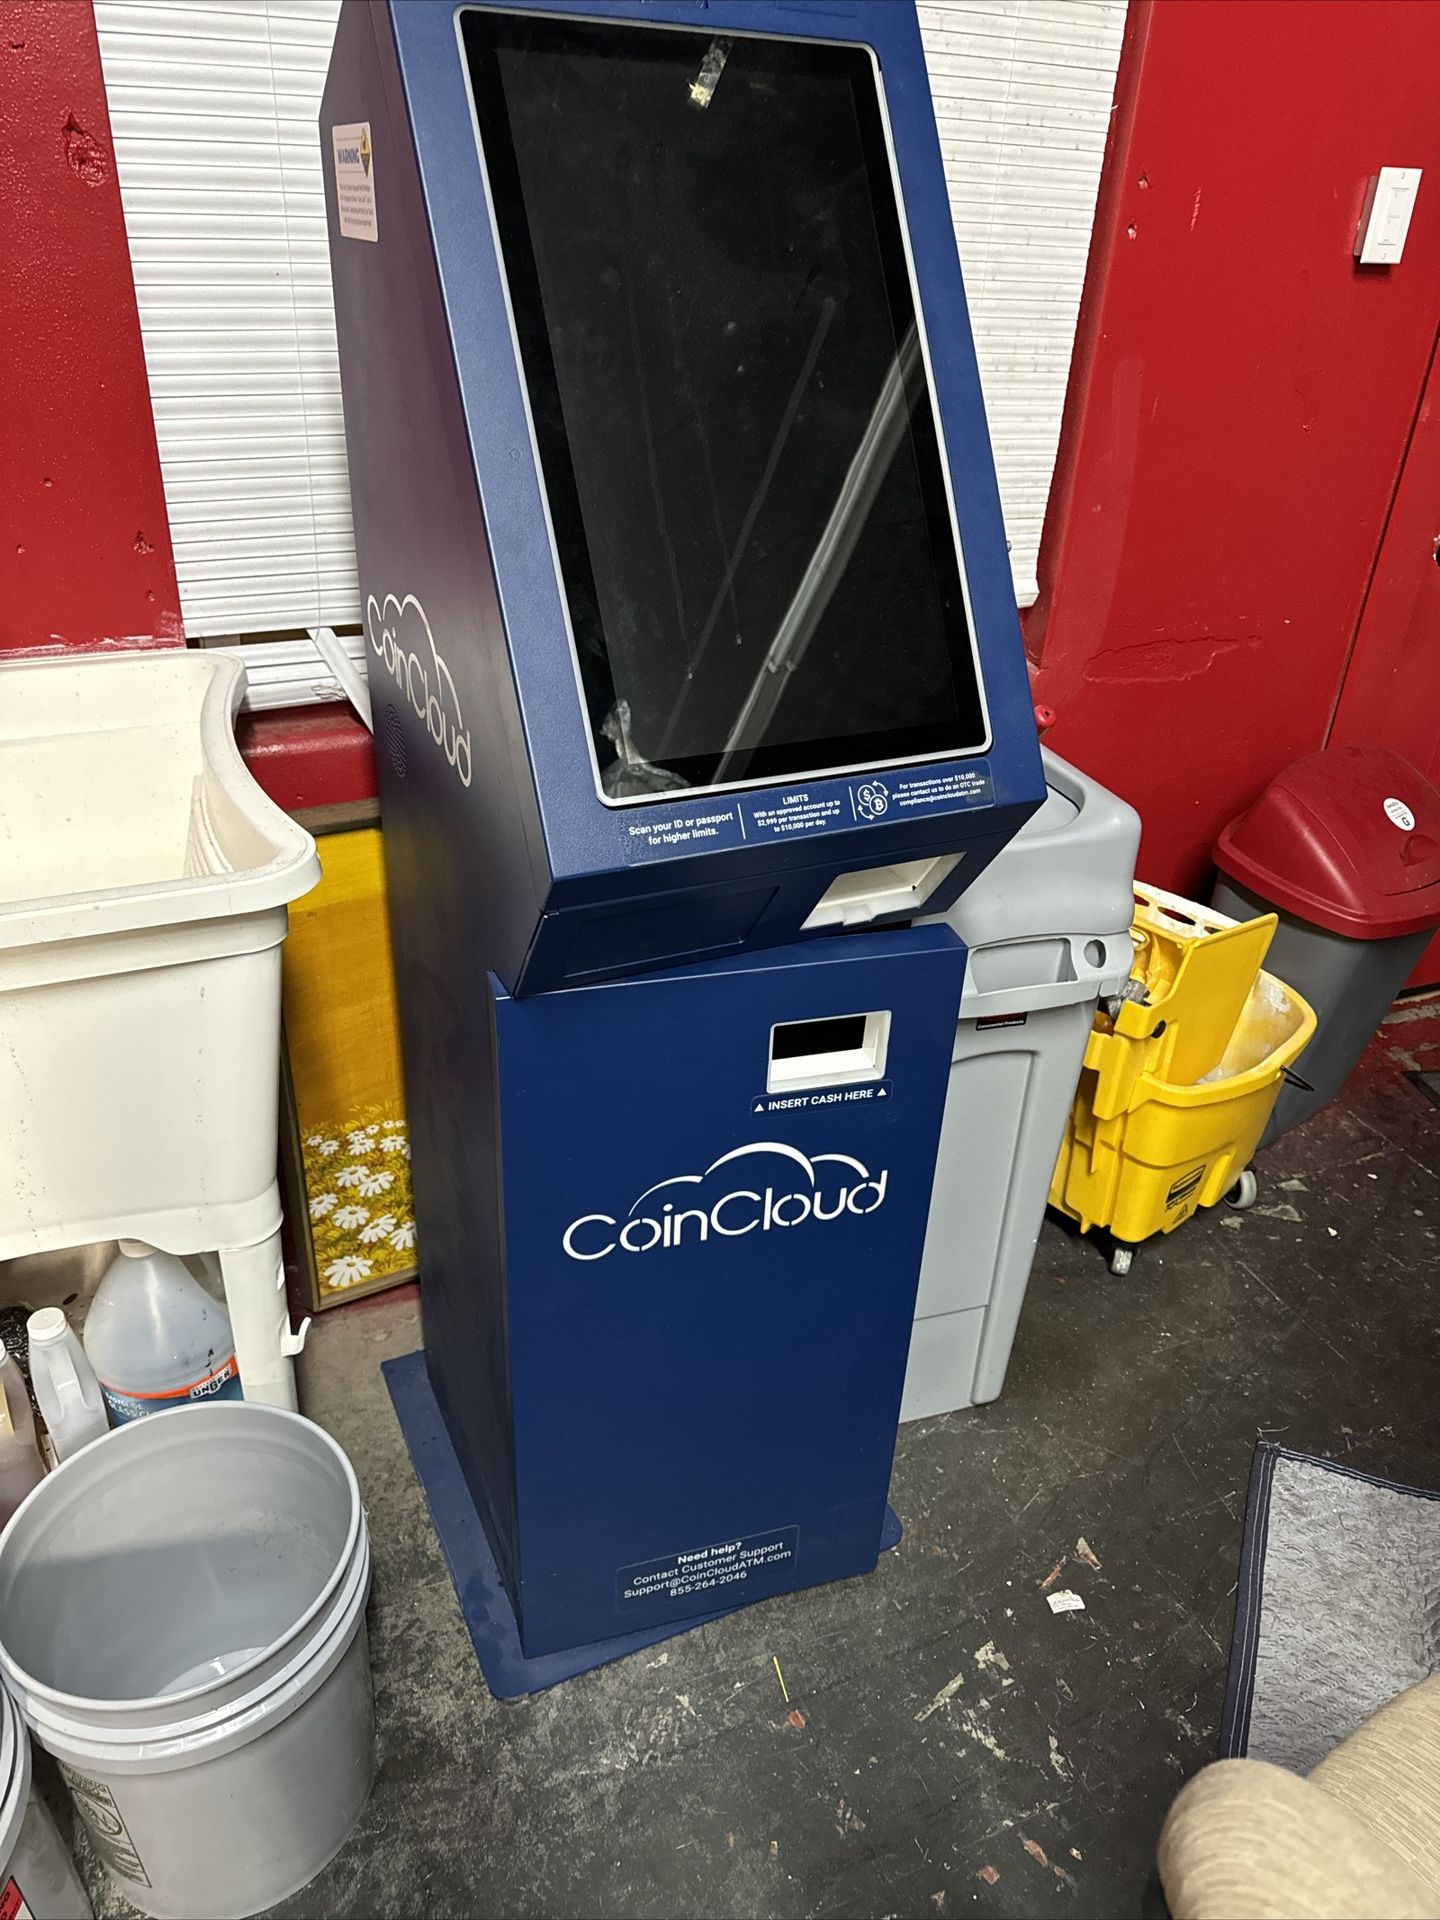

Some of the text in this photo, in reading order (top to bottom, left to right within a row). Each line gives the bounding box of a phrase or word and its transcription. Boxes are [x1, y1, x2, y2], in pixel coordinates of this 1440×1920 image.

[367, 594, 472, 788] CoinCloud
[892, 791, 910, 800] please
[910, 788, 930, 797] contact
[960, 781, 971, 789] OTC
[971, 779, 985, 787] trade
[909, 778, 942, 788] transactions
[942, 776, 954, 784] over
[954, 772, 976, 782] $10,000
[753, 811, 767, 819] With
[776, 805, 802, 816] approved
[803, 802, 825, 811] account
[782, 793, 809, 805] LIMITS
[628, 812, 734, 836] Scan your ID or passport
[757, 817, 777, 827] $2,999
[788, 811, 820, 822] transaction
[781, 822, 804, 832] $10,000
[648, 827, 719, 845] for higher limits.
[768, 1088, 874, 1111] INSERT CASH HERE
[562, 1169, 888, 1261] CoinCloud
[192, 1370, 231, 1397] UNGER
[633, 1541, 783, 1586] Contact Customer Support
[677, 1541, 742, 1565] Need help?
[624, 1550, 792, 1599] Support@CoinCloudATM.com
[670, 1571, 747, 1597] 855-264-2046
